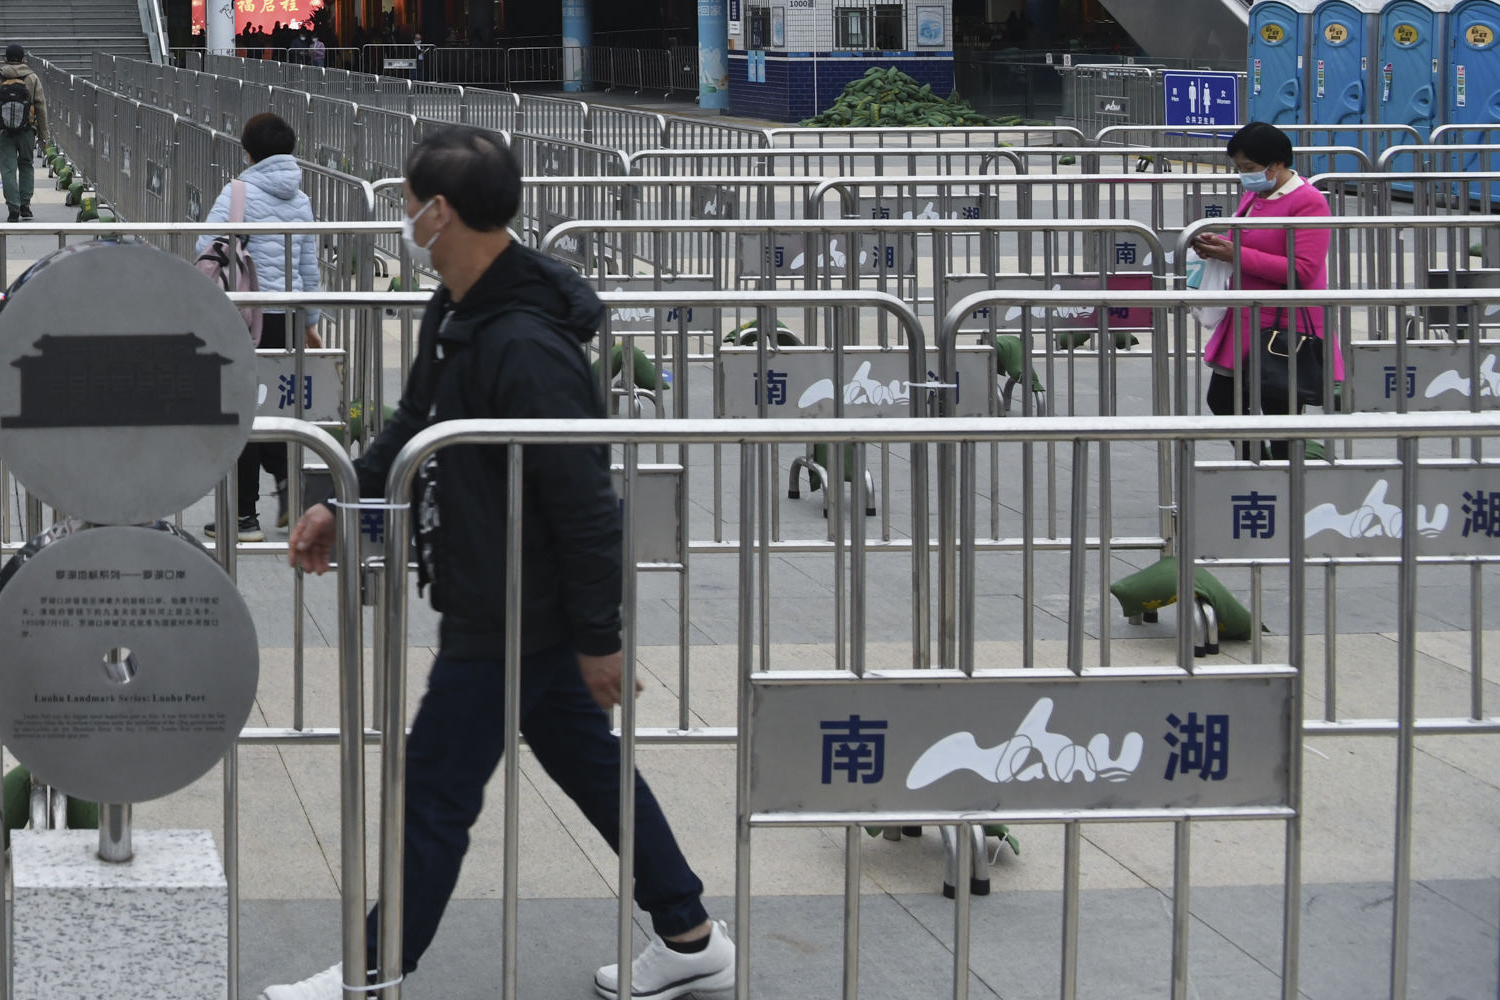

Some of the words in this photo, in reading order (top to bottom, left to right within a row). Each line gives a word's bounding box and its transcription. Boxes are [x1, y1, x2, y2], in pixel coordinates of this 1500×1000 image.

[1116, 242, 1136, 265] 南
[1231, 491, 1277, 540] 南
[1461, 490, 1500, 538] 湖
[819, 714, 889, 784] 南
[1163, 712, 1230, 782] 湖
